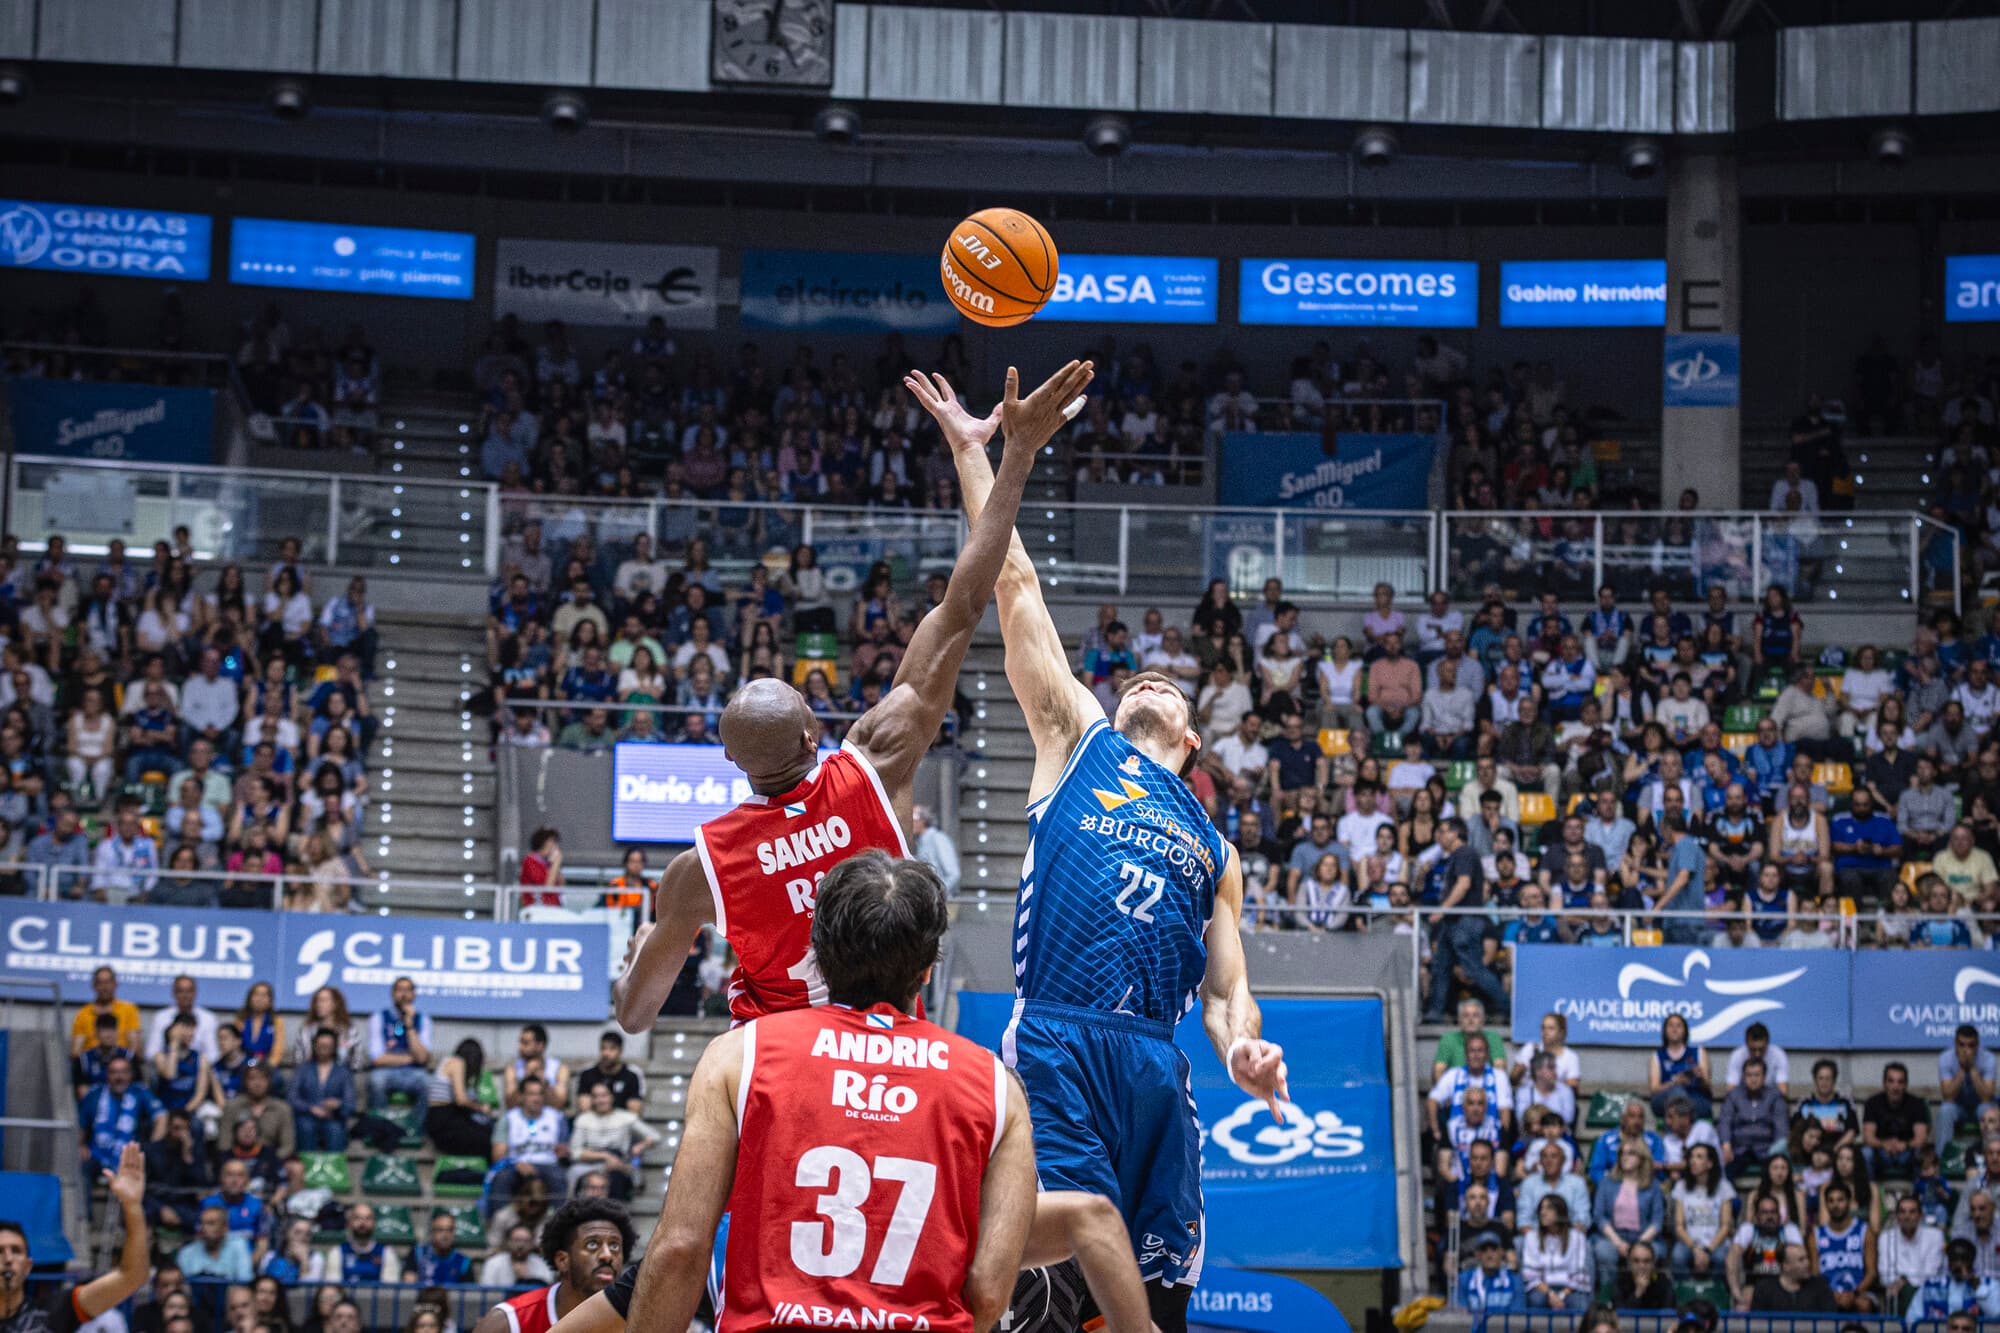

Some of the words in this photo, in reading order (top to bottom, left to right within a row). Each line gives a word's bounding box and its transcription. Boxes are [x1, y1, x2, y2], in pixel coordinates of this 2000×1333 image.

[53, 209, 187, 235] GRUAS
[51, 248, 185, 274] ODRA
[509, 266, 630, 297] iberCaja
[1262, 262, 1457, 297] Gescomes
[942, 252, 995, 314] Wilson
[1507, 284, 1577, 302] Gabino
[1956, 280, 2000, 309] ar
[1682, 280, 1723, 332] E
[618, 774, 692, 803] Diario
[695, 775, 728, 804] de
[756, 815, 852, 875] SAKHO
[1096, 814, 1197, 878] BURGOS
[1115, 861, 1167, 924] 22
[8, 916, 254, 962] CLIBUR
[343, 931, 583, 974] CLIBUR
[811, 1028, 949, 1070] ANDRIC
[845, 1110, 859, 1118] DE
[861, 1112, 900, 1122] GALICIA
[790, 1145, 937, 1286] 37
